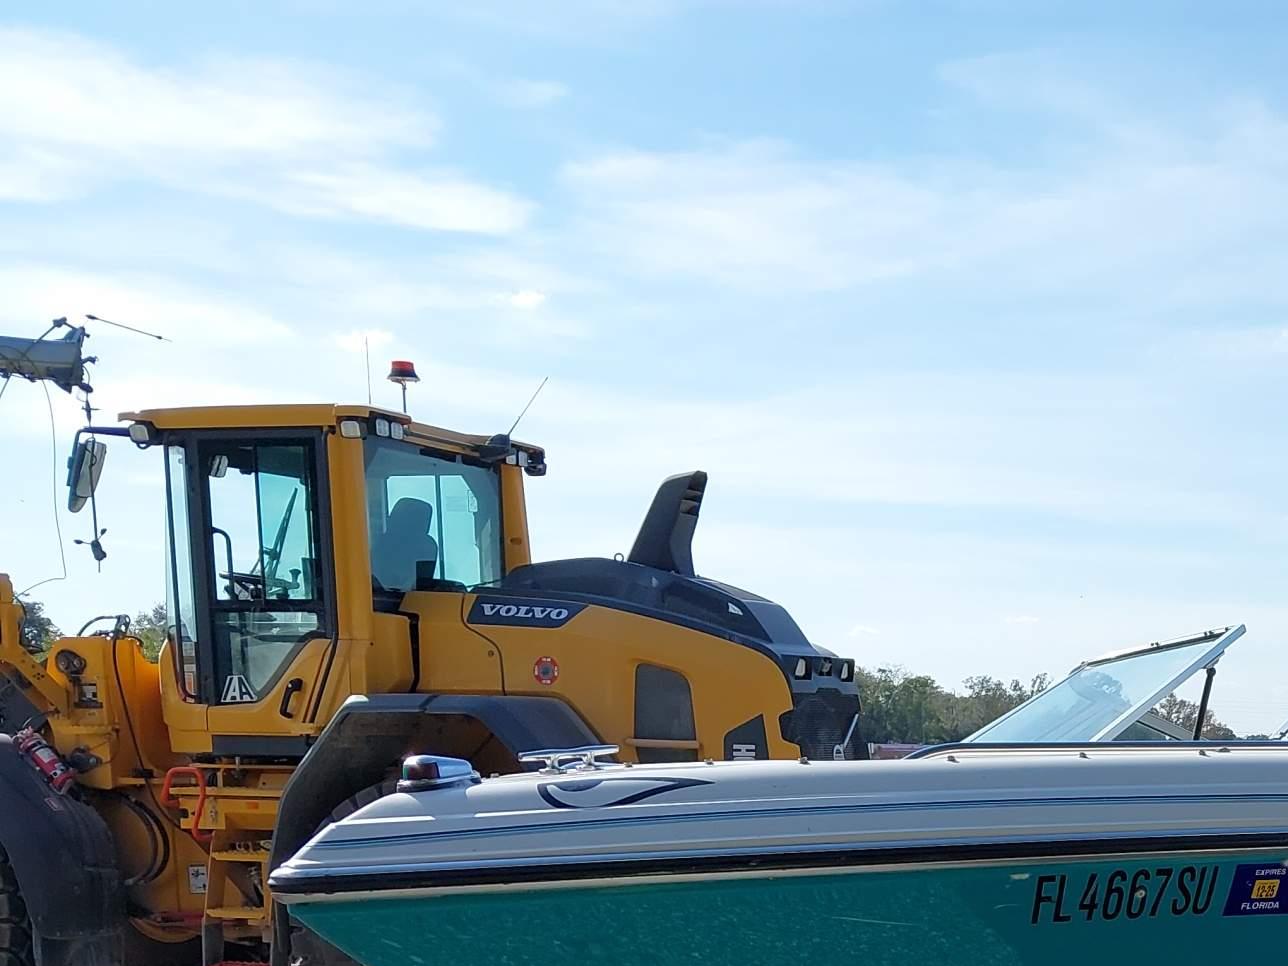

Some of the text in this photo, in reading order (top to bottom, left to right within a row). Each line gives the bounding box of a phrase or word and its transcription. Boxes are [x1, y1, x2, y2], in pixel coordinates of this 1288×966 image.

[480, 603, 569, 620] VOLVO
[1255, 868, 1287, 876] EXPIRES
[1240, 901, 1280, 910] FLORIDA
